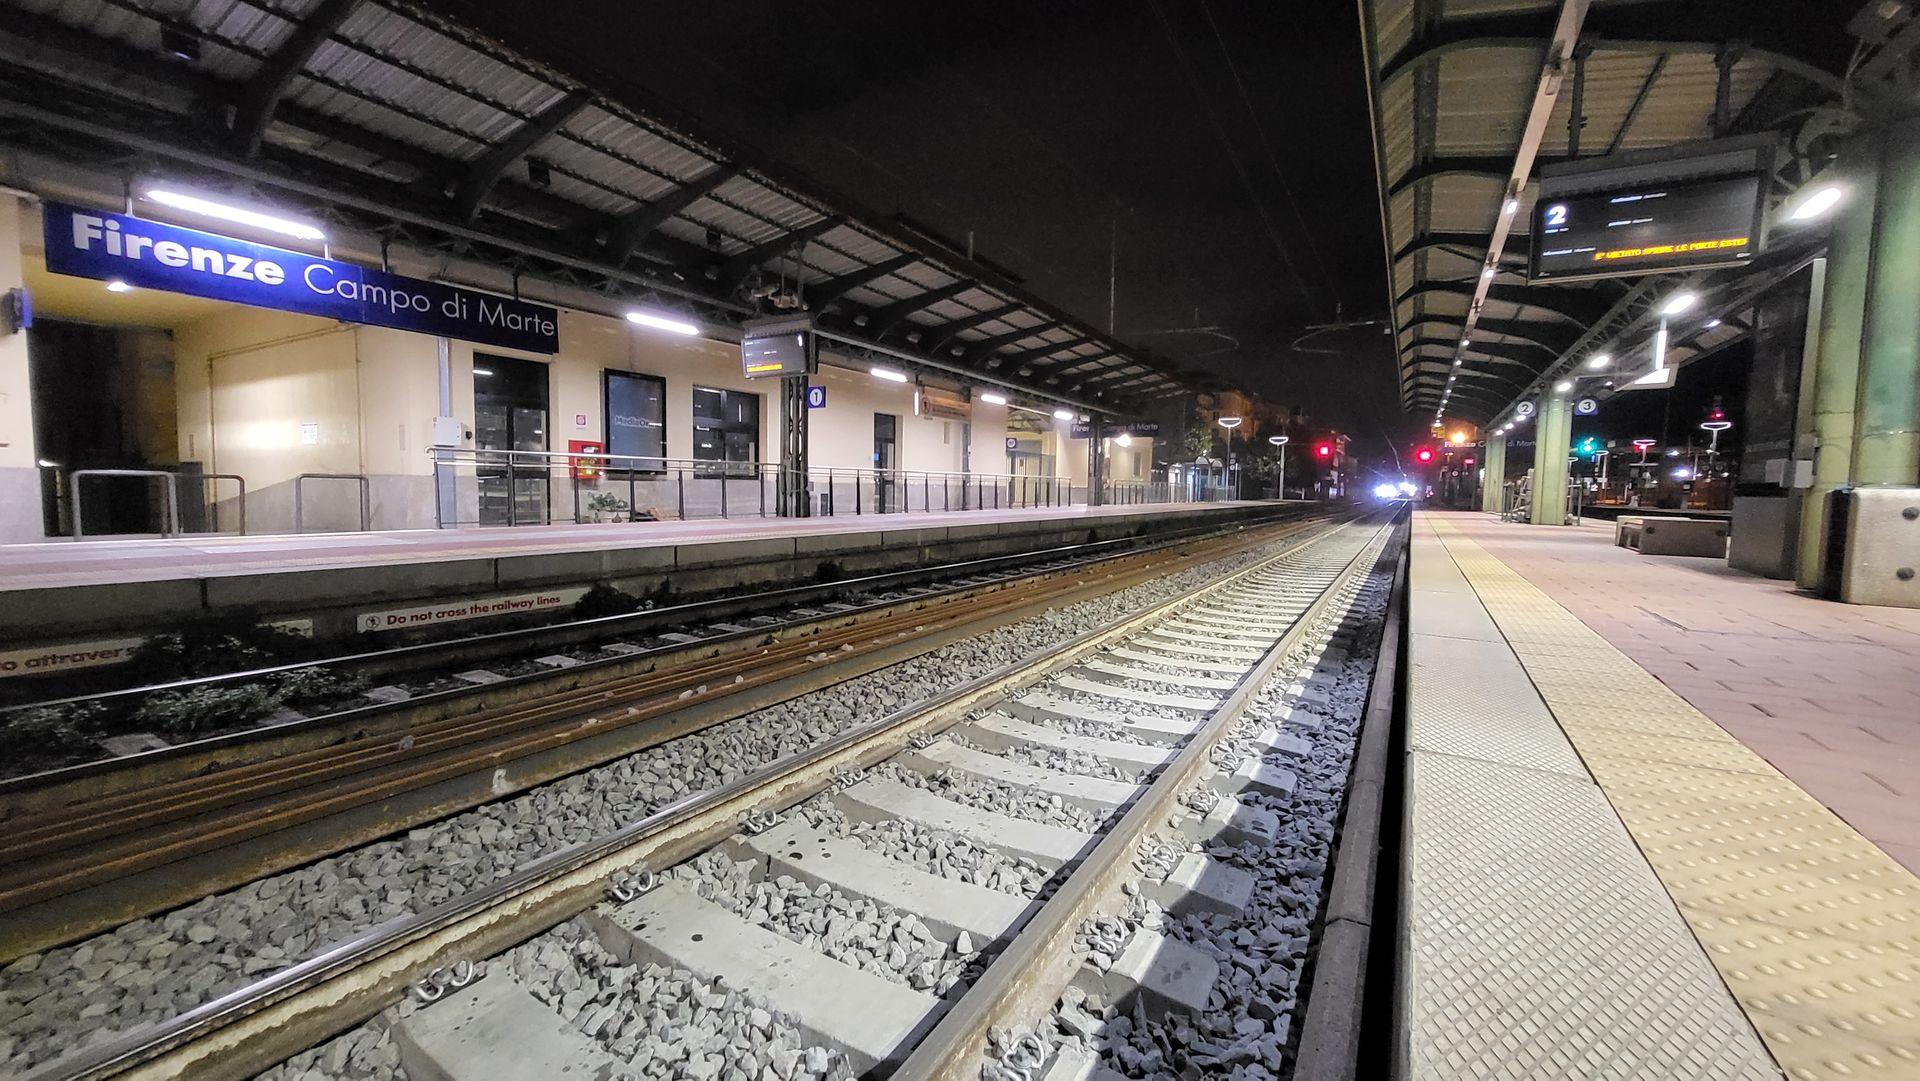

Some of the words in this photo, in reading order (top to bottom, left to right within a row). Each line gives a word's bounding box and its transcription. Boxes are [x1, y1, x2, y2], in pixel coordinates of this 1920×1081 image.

[1548, 204, 1567, 225] 2
[1675, 244, 1688, 252] LE
[72, 213, 285, 286] Firenze
[304, 263, 431, 314] Campo
[441, 292, 467, 320] di
[478, 298, 555, 336] Marte
[1516, 440, 1537, 448] Mart
[387, 614, 406, 626] Do
[410, 610, 433, 622] not
[436, 607, 467, 619] cross
[469, 604, 489, 615] the
[492, 599, 535, 612] railway
[536, 595, 561, 605] lines
